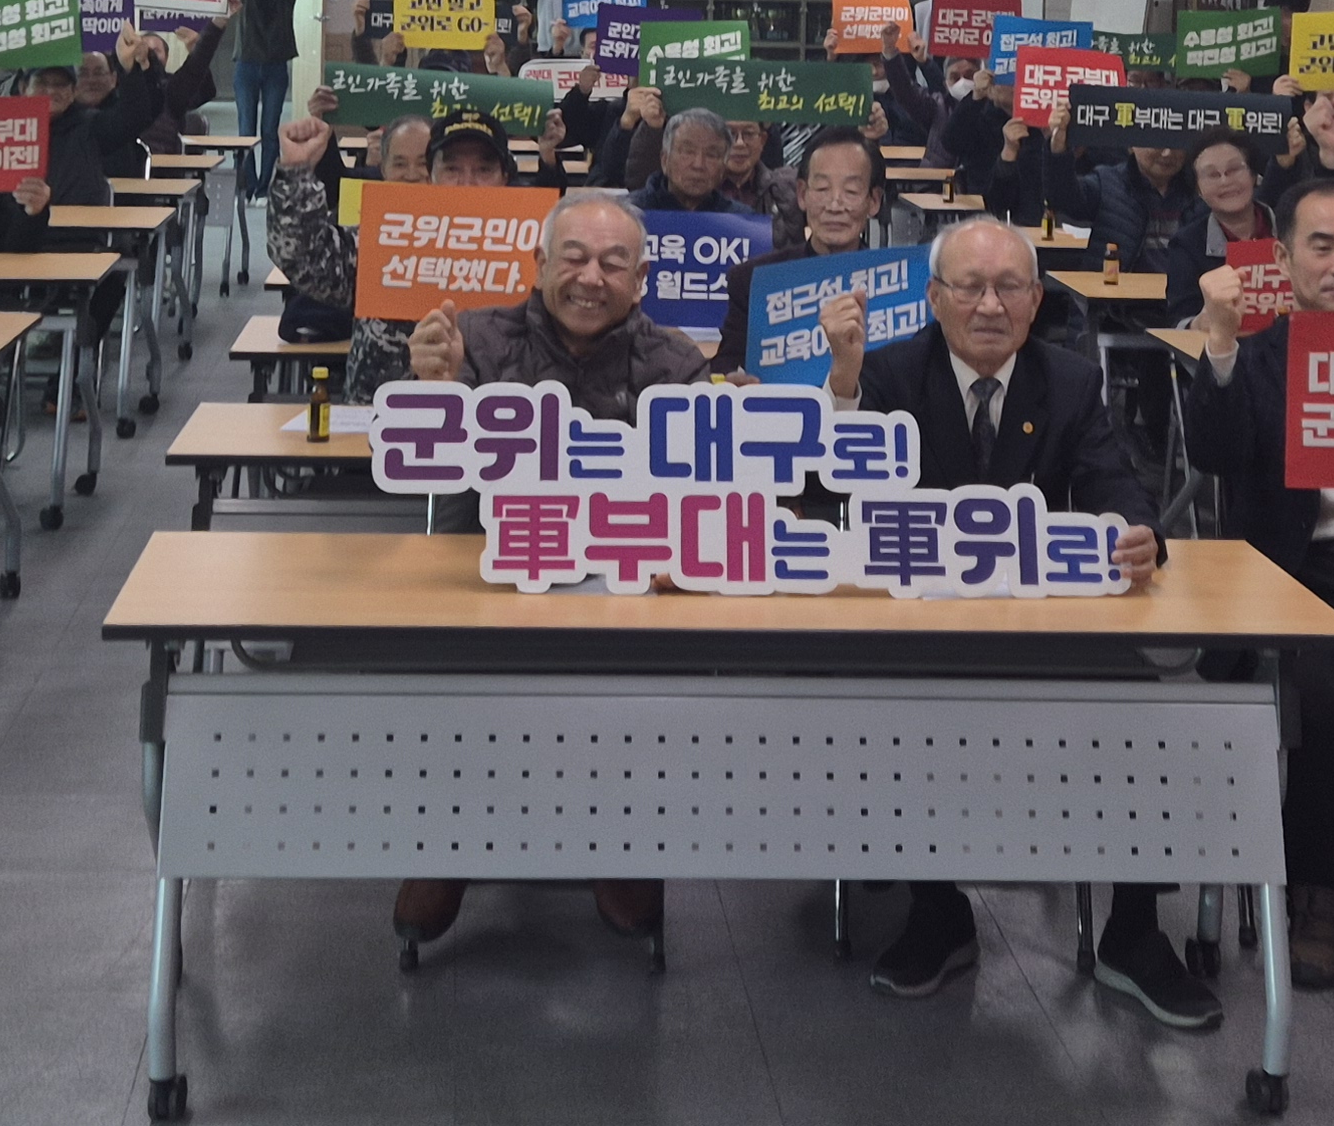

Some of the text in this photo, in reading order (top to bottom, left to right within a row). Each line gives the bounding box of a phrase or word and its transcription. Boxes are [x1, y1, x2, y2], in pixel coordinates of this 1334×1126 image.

[31, 16, 75, 45] 최고!
[938, 8, 965, 26] 대구
[1236, 15, 1274, 42] 최고!
[703, 30, 743, 57] 최고!
[1239, 35, 1278, 62] 최고!
[429, 76, 470, 101] 위한
[757, 67, 796, 93] 위한
[1023, 64, 1063, 86] 대구
[813, 91, 866, 118] 선택!
[1076, 104, 1111, 128] 대구
[1187, 108, 1221, 131] 대구
[377, 212, 545, 253] 군위군민이
[692, 235, 751, 265] OK!
[380, 254, 527, 295] 선택했다.
[867, 299, 928, 343] 최고!
[379, 392, 910, 484] 군위는 대구로!
[490, 490, 1122, 588] 軍부대는 軍위로!
